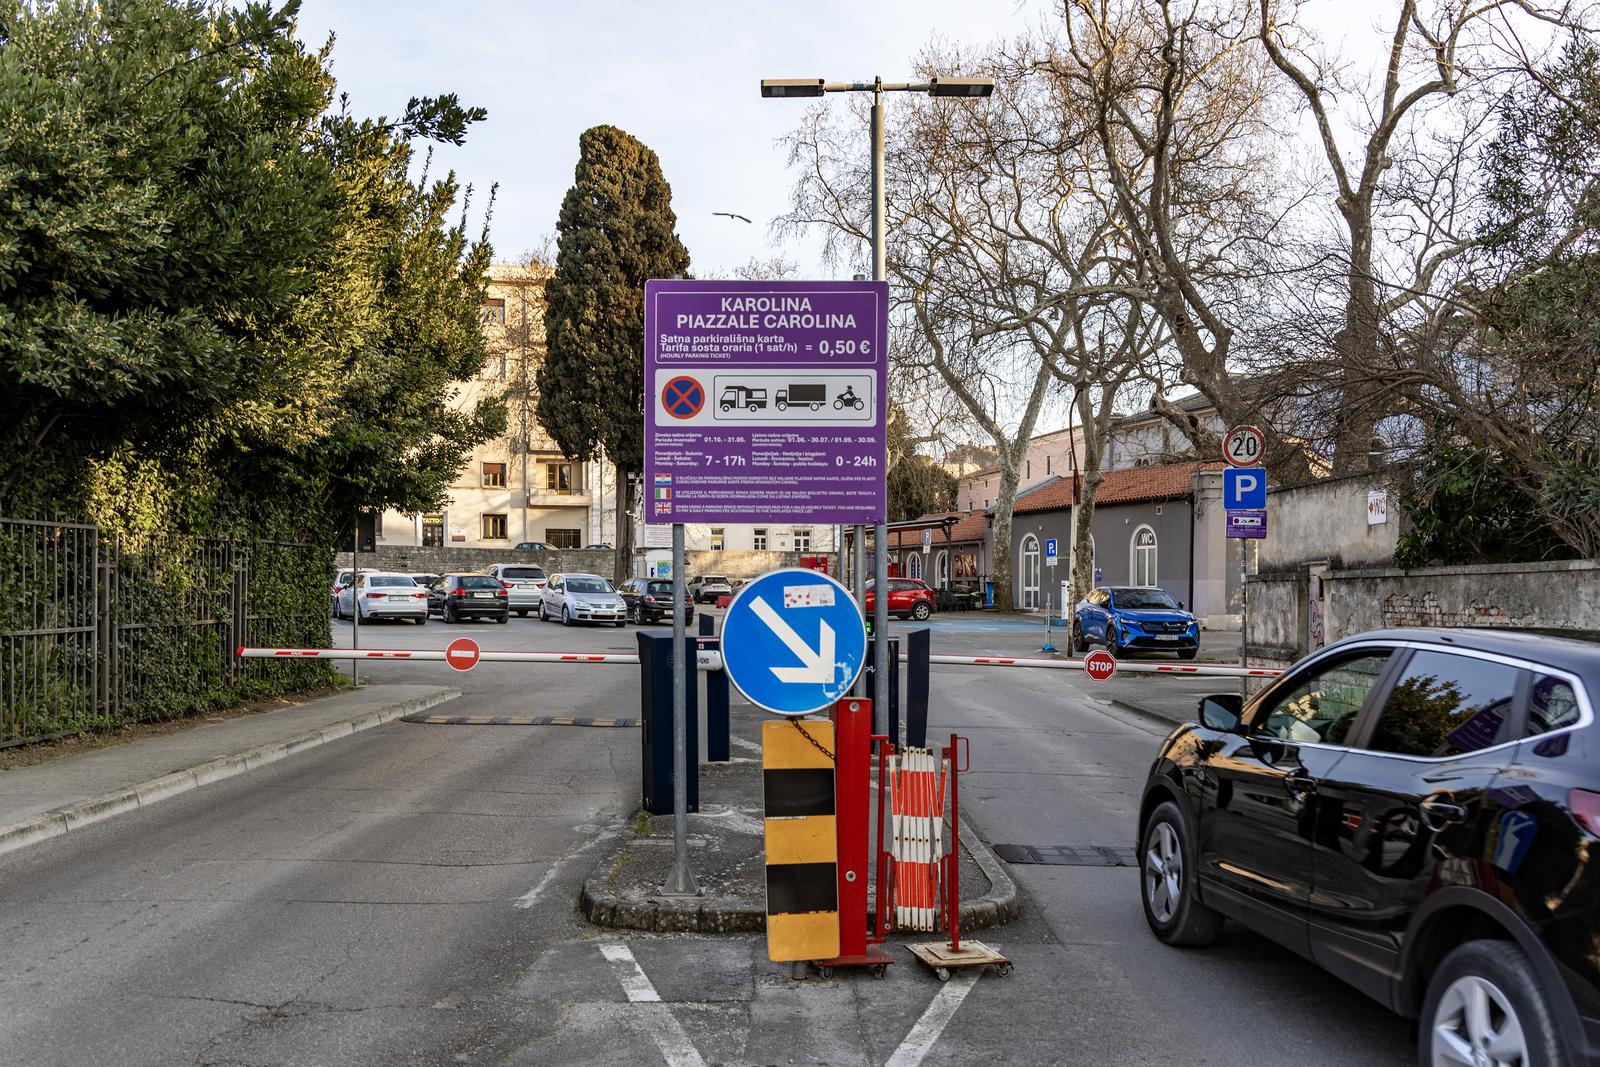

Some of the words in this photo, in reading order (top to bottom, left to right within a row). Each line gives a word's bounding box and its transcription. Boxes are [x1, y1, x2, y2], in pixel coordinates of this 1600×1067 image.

[722, 297, 812, 312] KAROLINA
[677, 314, 759, 328] PIAZZALE
[764, 314, 856, 329] CAROLINA
[660, 334, 690, 343] Satna
[693, 334, 755, 345] parkirališna
[757, 334, 784, 343] karta
[660, 343, 689, 352] Tarifa
[722, 344, 752, 352] oraria
[755, 343, 764, 353] (1
[766, 343, 797, 353] sat/h)
[819, 341, 855, 356] 0,50
[860, 341, 870, 354] €
[1233, 437, 1257, 456] 20
[705, 456, 713, 466] 7
[724, 456, 746, 466] 17h
[836, 456, 843, 466] 0
[854, 456, 876, 466] 24h
[1235, 475, 1257, 501] P
[1141, 533, 1152, 544] WC
[1048, 543, 1054, 554] P
[1089, 661, 1112, 672] STOP
